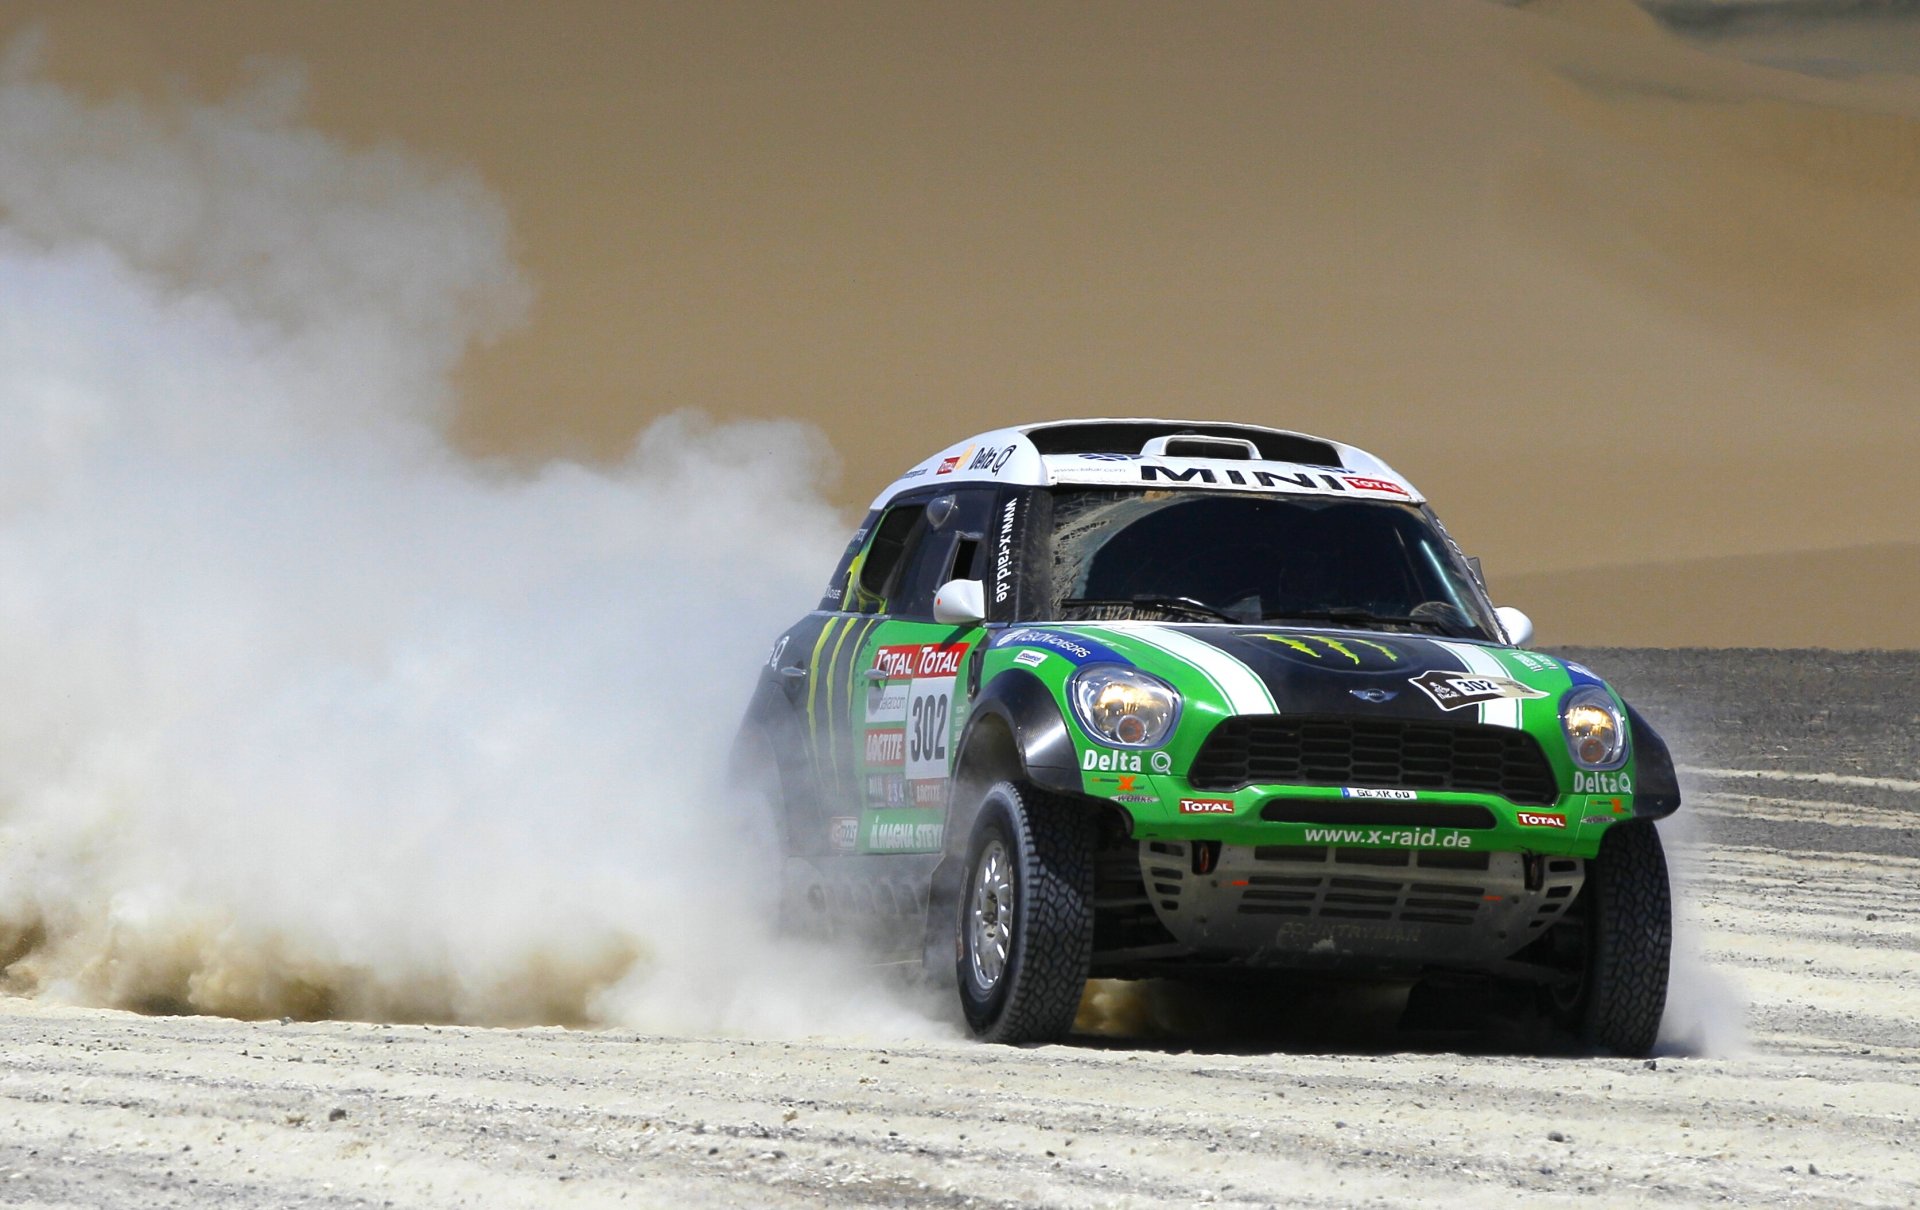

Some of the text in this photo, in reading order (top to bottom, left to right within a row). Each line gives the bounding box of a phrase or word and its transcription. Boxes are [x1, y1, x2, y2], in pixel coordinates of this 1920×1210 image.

[1140, 465, 1345, 490] MINI
[1354, 478, 1407, 494] TOTAL
[996, 498, 1018, 603] www.x-raid.de
[918, 646, 960, 675] TOTAL
[1457, 679, 1500, 692] 302
[911, 693, 948, 762] 302
[866, 733, 903, 761] LOCTITE
[1082, 749, 1142, 772] Delta
[1181, 800, 1233, 812] TOTAL
[1518, 813, 1565, 827] TOTAL
[878, 823, 915, 849] MAGNA
[1304, 827, 1471, 848] www.x-raid.de
